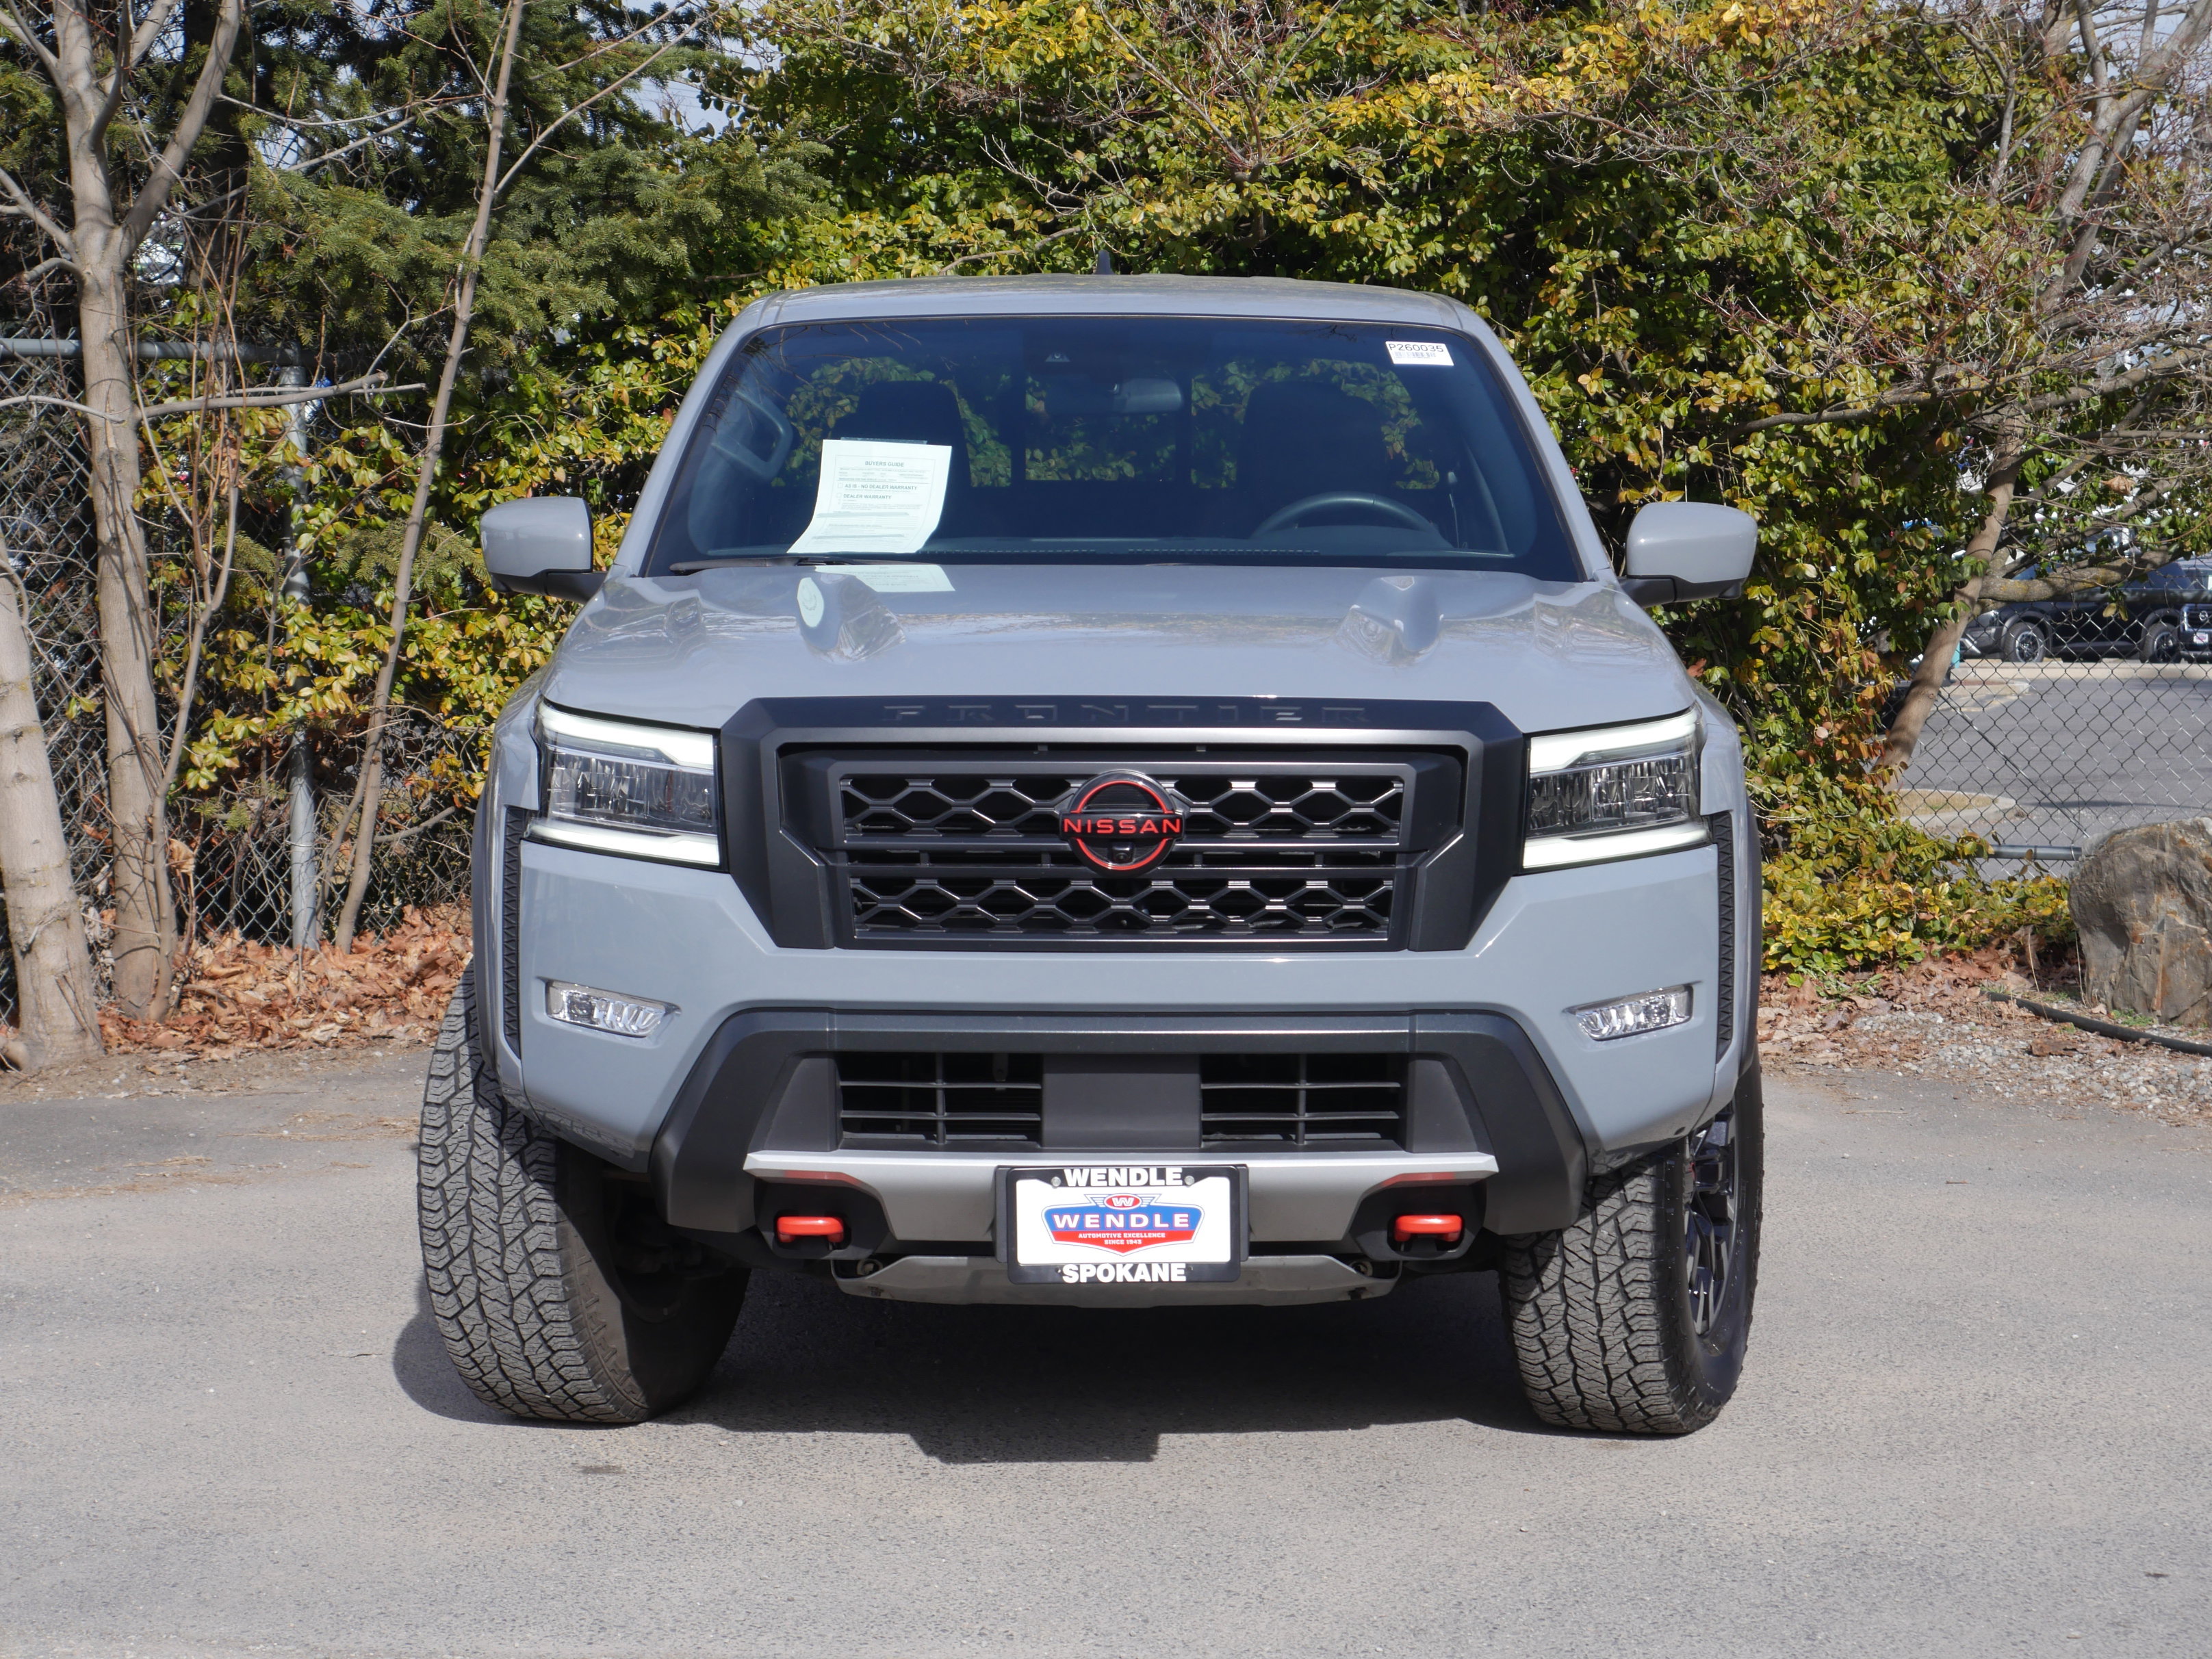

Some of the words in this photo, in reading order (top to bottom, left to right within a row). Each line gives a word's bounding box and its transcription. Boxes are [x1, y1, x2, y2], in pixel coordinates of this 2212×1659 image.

[1389, 344, 1444, 352] P260035
[882, 704, 1370, 723] FRONTIER
[1064, 819, 1181, 834] NISSAN
[1064, 1167, 1183, 1187] WENDLE
[1052, 1213, 1189, 1229] WENDLE
[1062, 1263, 1187, 1284] SPOKANE
